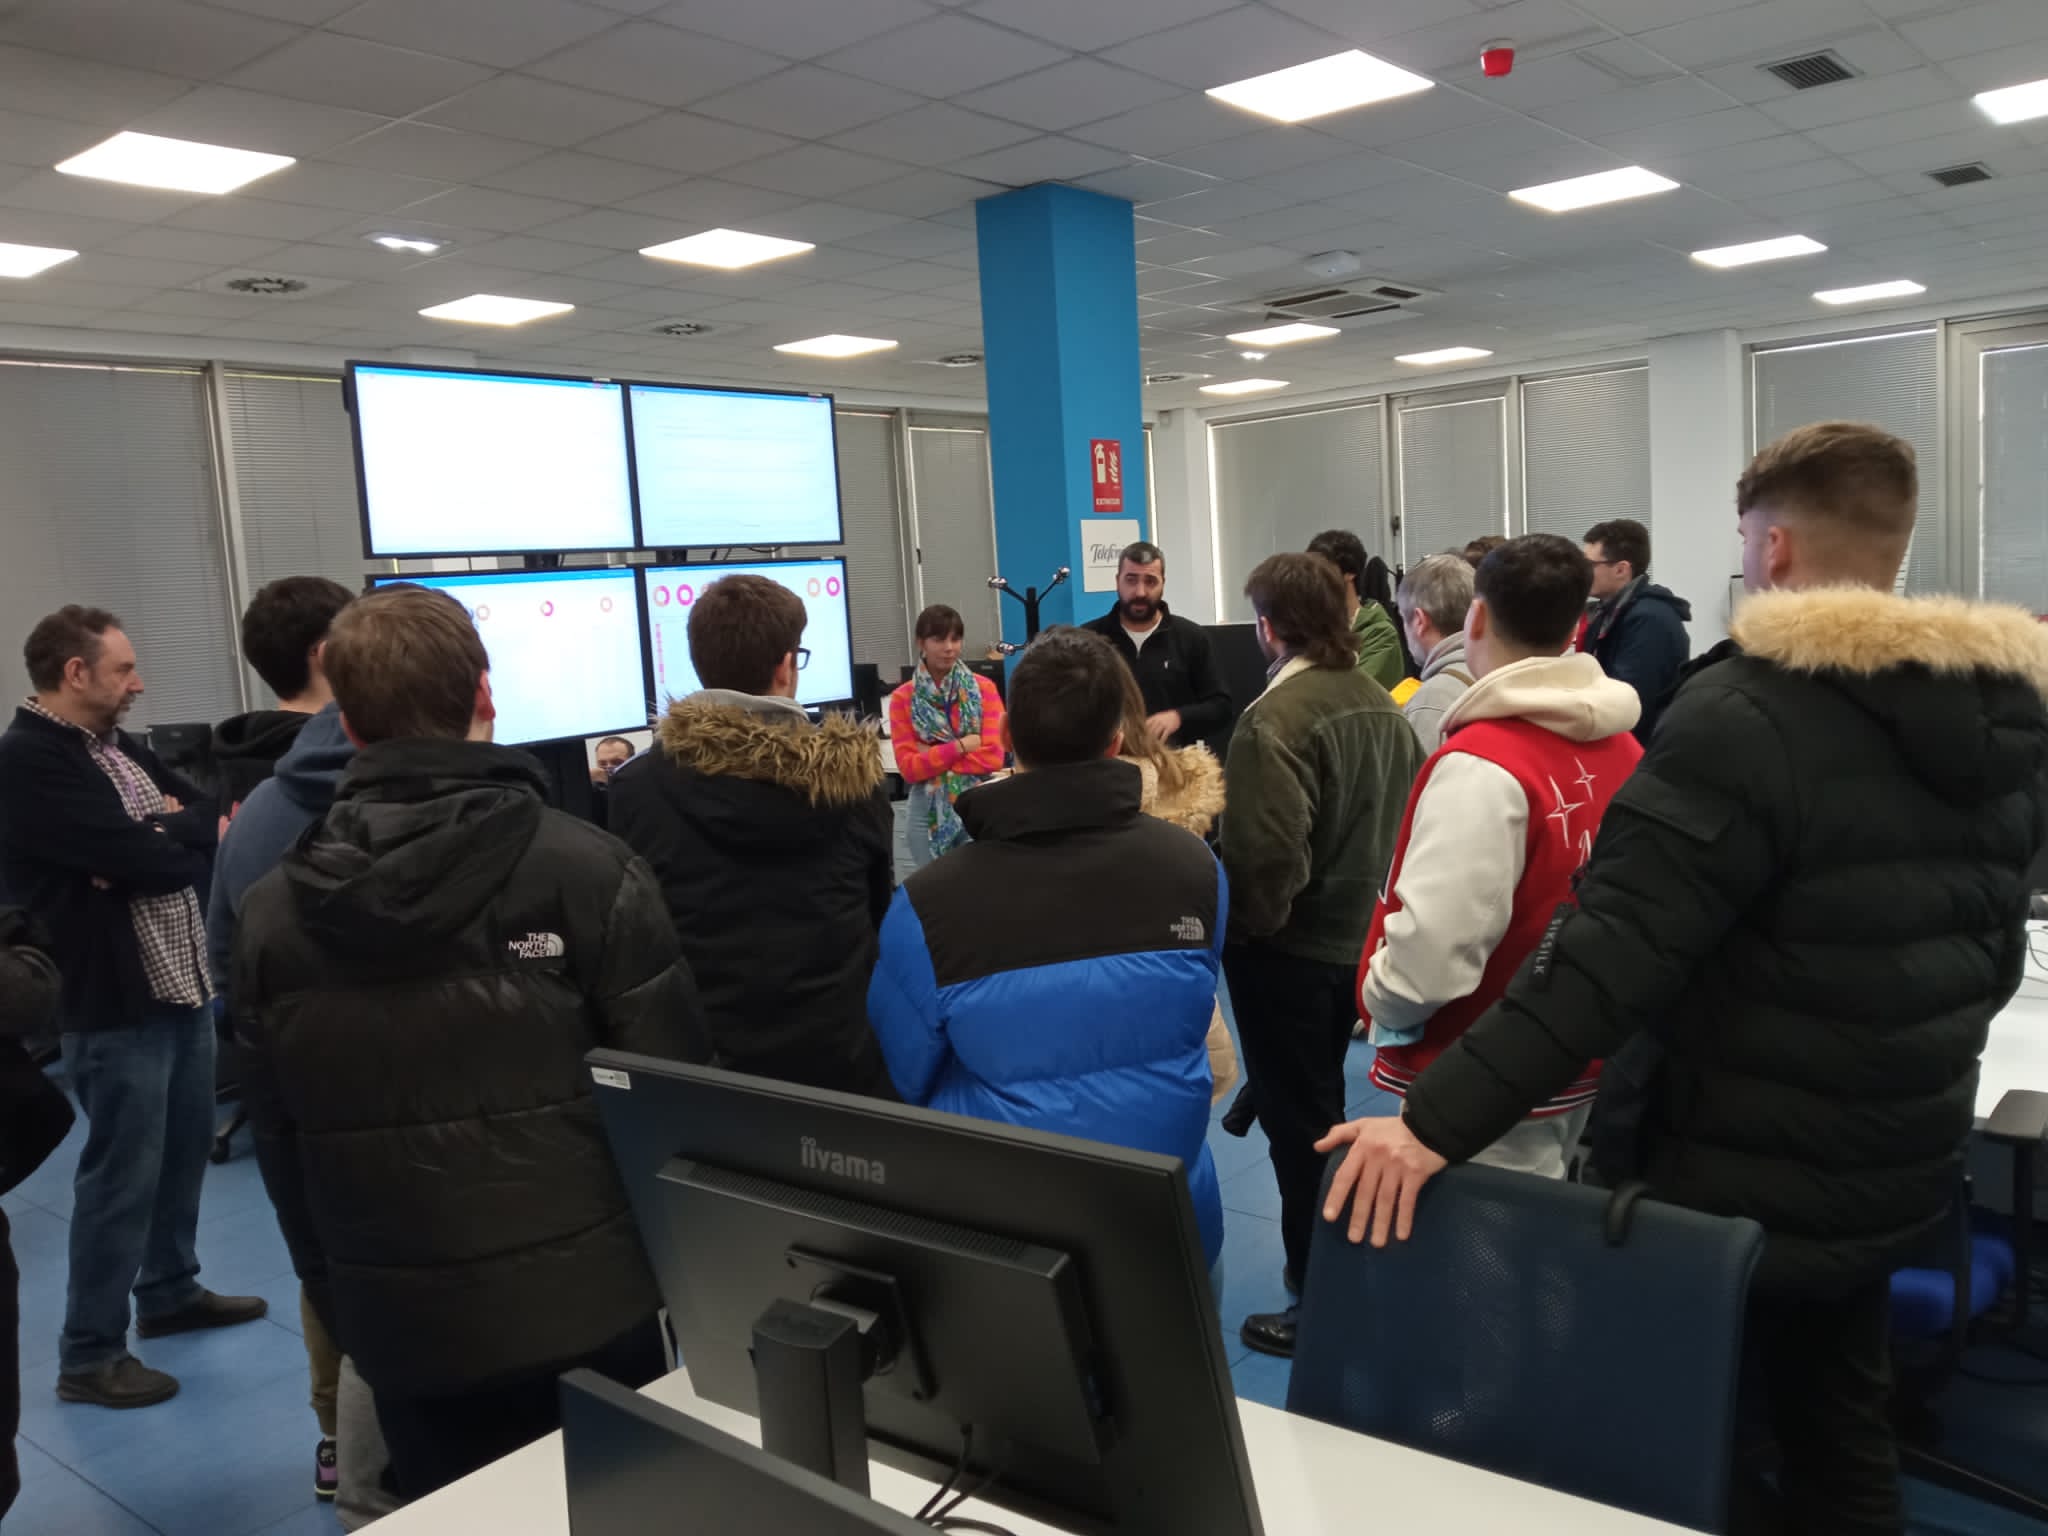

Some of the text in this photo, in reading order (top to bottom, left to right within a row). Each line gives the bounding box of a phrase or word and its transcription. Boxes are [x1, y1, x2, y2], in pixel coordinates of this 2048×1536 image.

[527, 932, 547, 942] THE
[508, 941, 547, 951] NORTH
[1533, 918, 1563, 975] SIKSILK
[519, 950, 546, 959] FACE
[800, 1135, 886, 1186] iiyama
